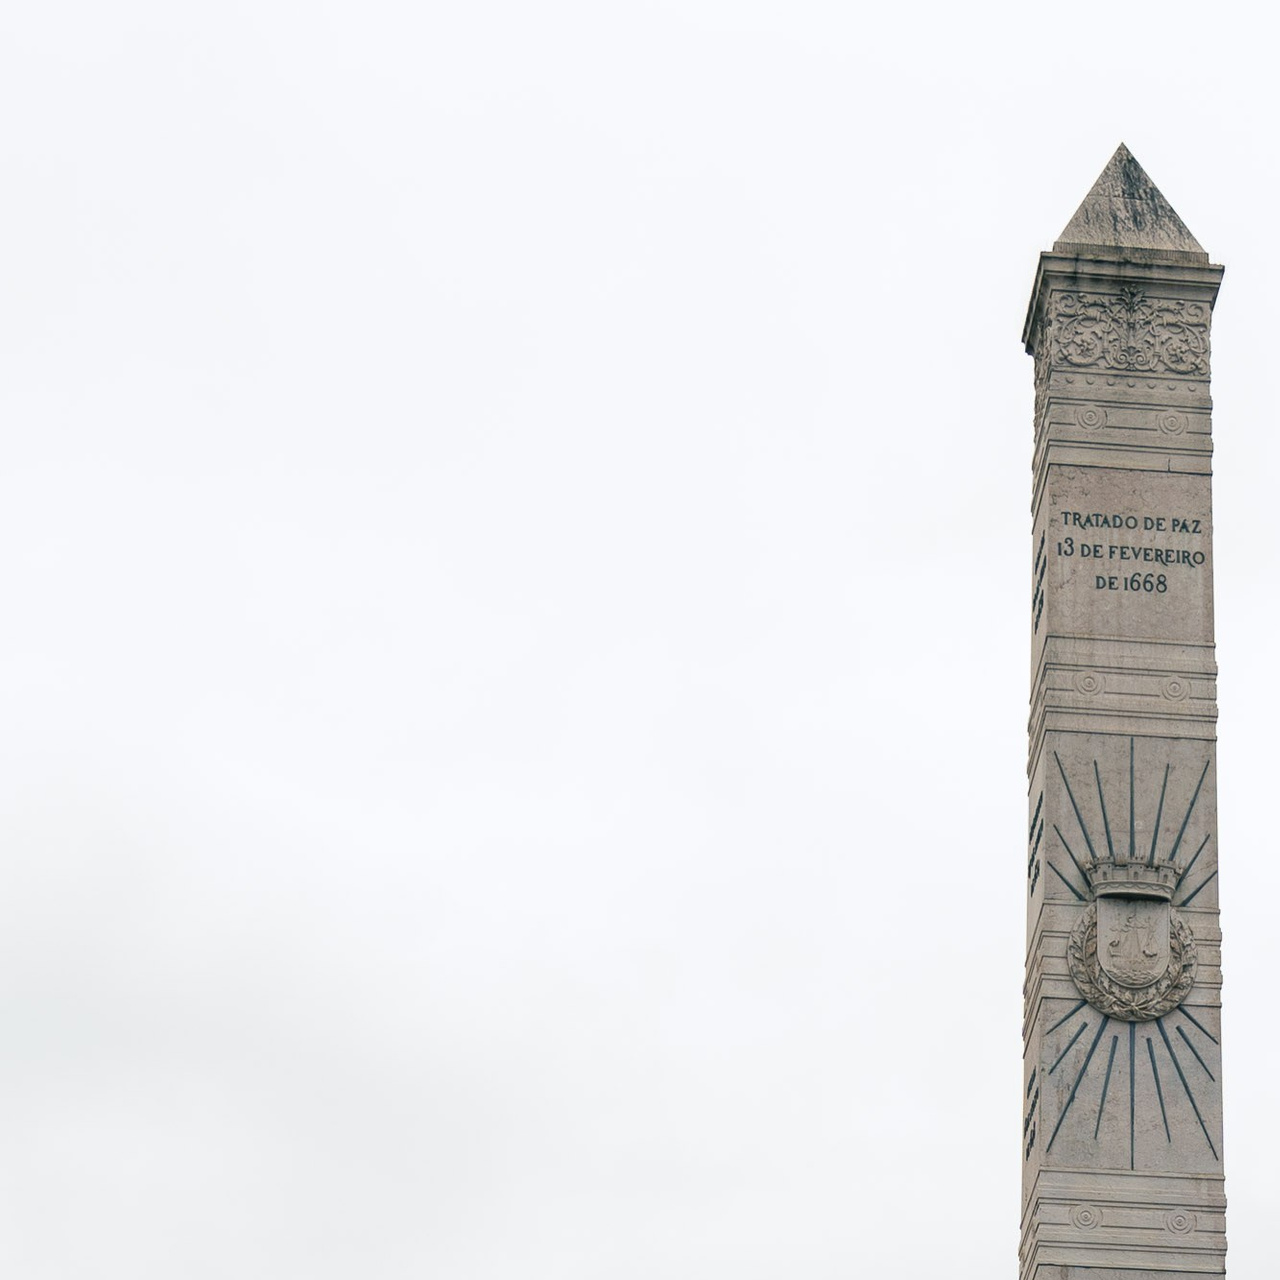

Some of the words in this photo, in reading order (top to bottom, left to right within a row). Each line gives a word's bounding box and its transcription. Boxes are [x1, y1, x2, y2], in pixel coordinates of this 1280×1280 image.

[1061, 511, 1138, 530] TRATADO
[1144, 517, 1166, 531] DE
[1057, 537, 1075, 556] 13
[1081, 544, 1103, 558] DE
[1109, 546, 1205, 568] FEVEREIRO
[1095, 576, 1119, 590] DE
[1124, 572, 1168, 593] 1668
